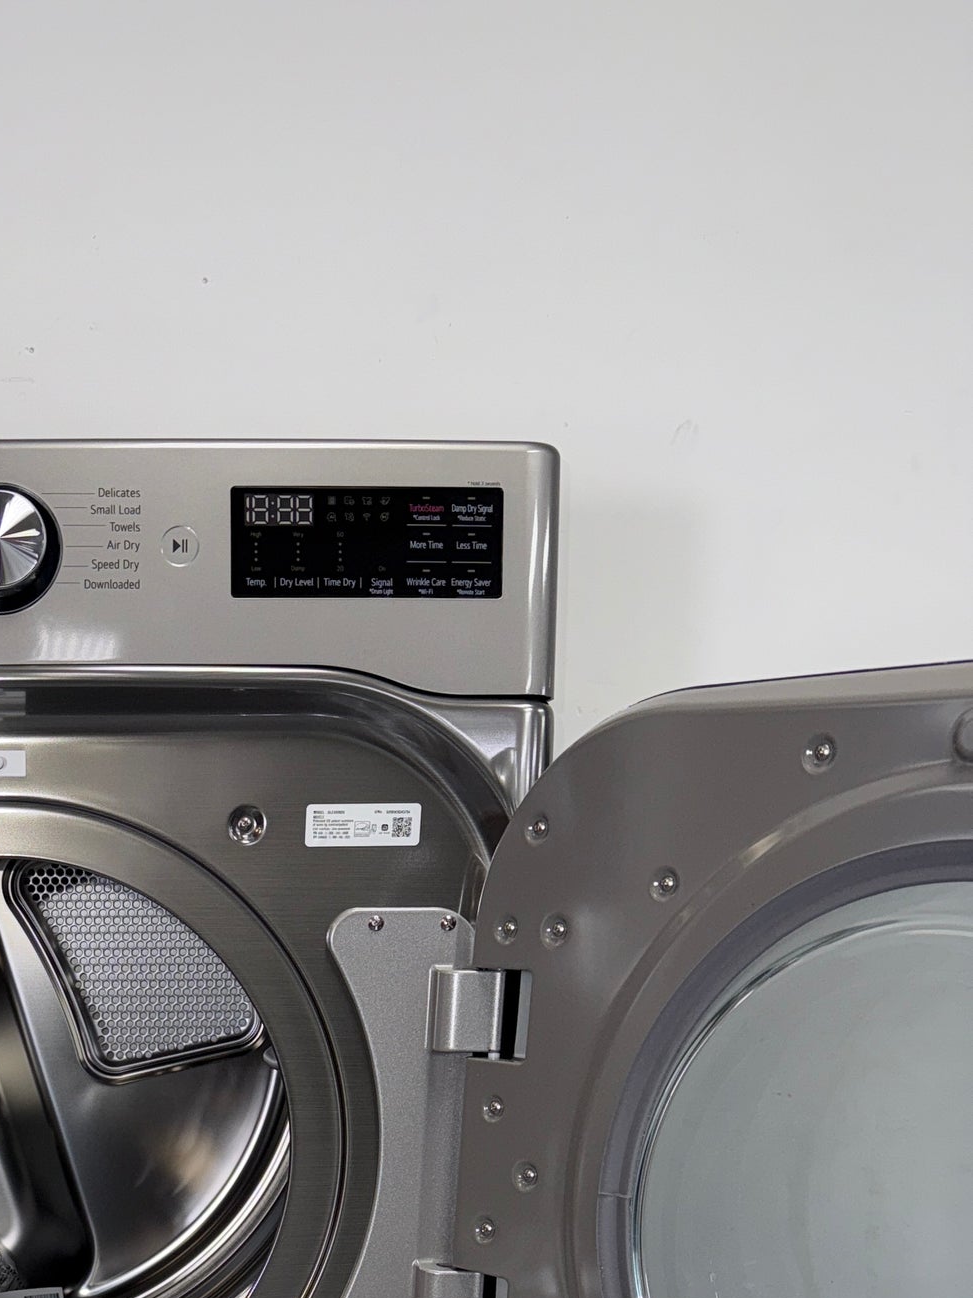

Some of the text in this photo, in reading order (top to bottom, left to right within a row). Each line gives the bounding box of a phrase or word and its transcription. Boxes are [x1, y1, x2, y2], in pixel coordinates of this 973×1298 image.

[98, 487, 141, 498] Delicates
[90, 504, 141, 515] Small Load
[409, 504, 445, 512] TurboSteam
[452, 504, 493, 514] Damp Dry Signal
[110, 521, 141, 532] Towels
[107, 540, 140, 552] Air Dry
[410, 541, 443, 550] More Time
[456, 541, 487, 550] Less Time
[91, 559, 139, 572] Speed Dry
[84, 579, 140, 590] Downloaded
[246, 578, 267, 588] Temp.
[280, 577, 314, 588] Dry Level
[323, 577, 356, 588] Time Dry
[371, 578, 393, 588] Signal
[407, 578, 446, 587] Wrinkle Care
[451, 578, 491, 588] Energy Saver
